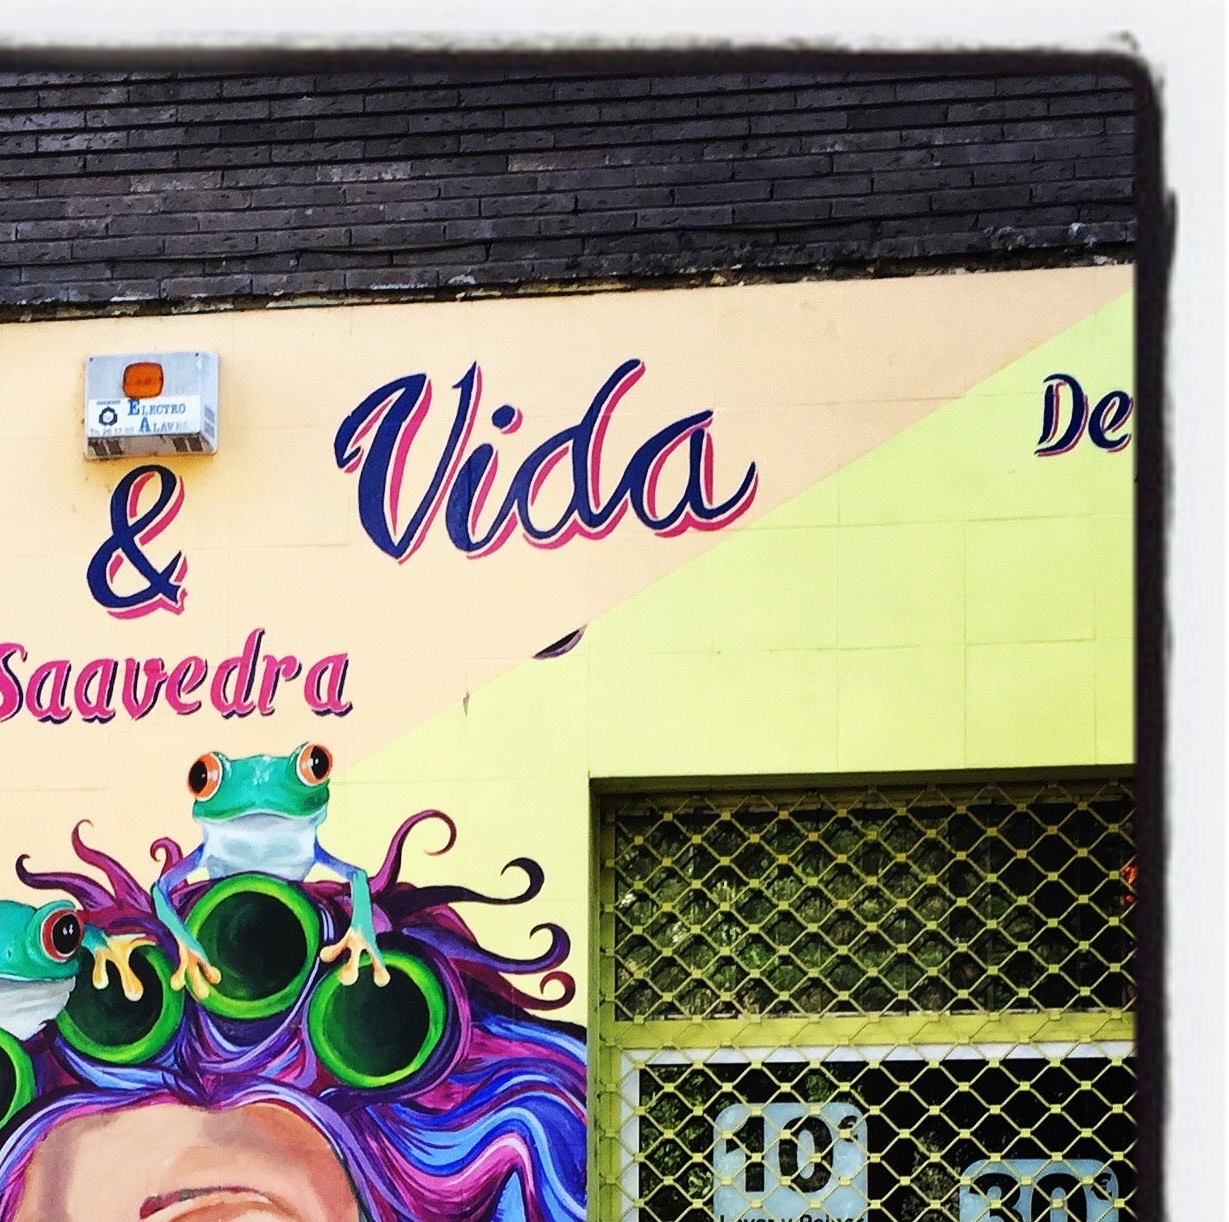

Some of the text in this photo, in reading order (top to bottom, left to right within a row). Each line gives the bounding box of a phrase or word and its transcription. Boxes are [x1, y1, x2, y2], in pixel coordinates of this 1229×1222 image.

[86, 464, 188, 620] &
[333, 358, 758, 566] Vida
[1034, 373, 1133, 457] De
